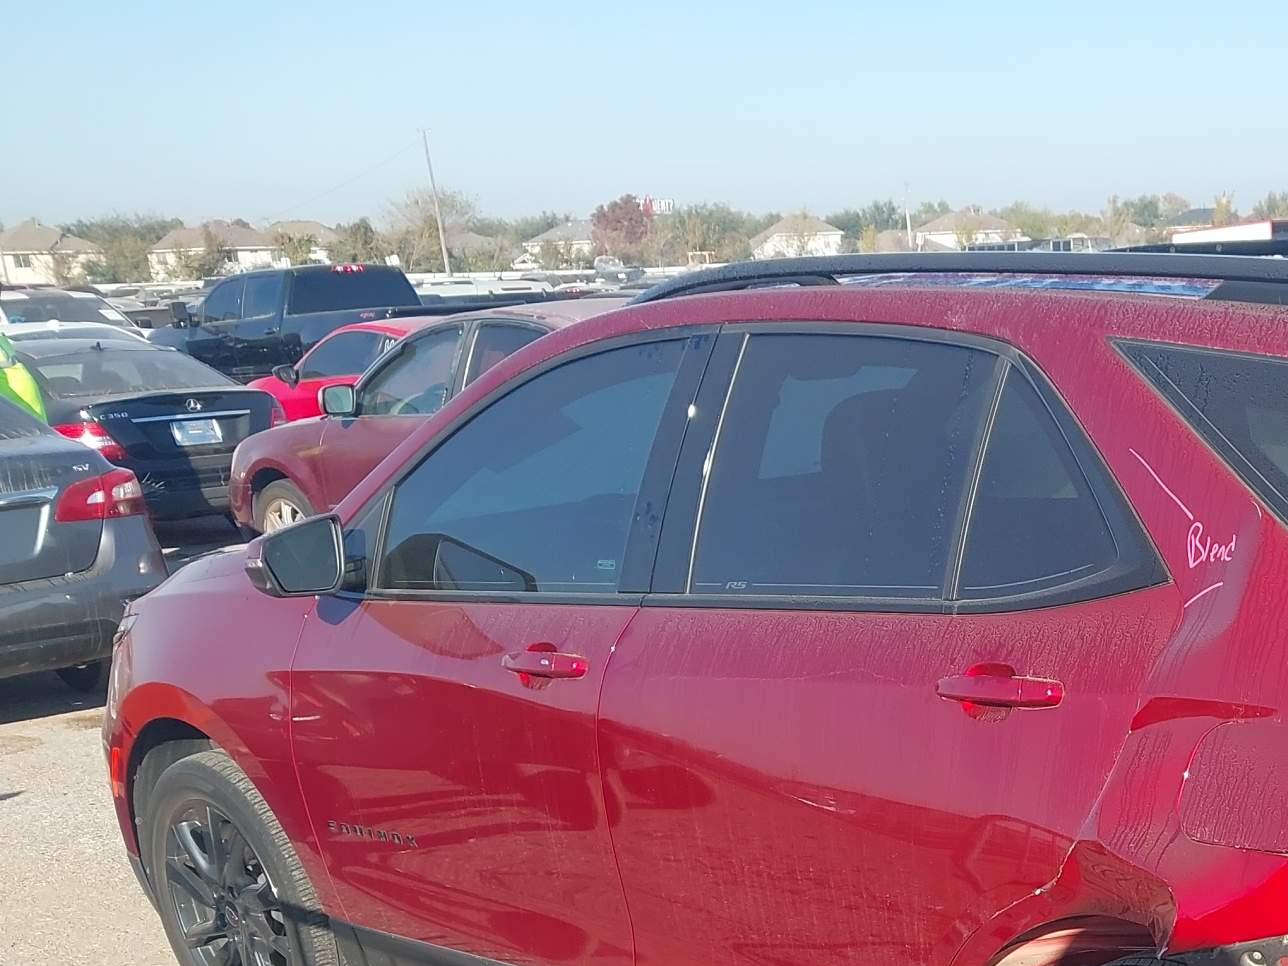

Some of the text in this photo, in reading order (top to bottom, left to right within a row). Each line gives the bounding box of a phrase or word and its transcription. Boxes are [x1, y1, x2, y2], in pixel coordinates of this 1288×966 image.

[1187, 521, 1237, 569] Blend
[725, 581, 748, 590] RS
[327, 819, 418, 848] EQUINOX
